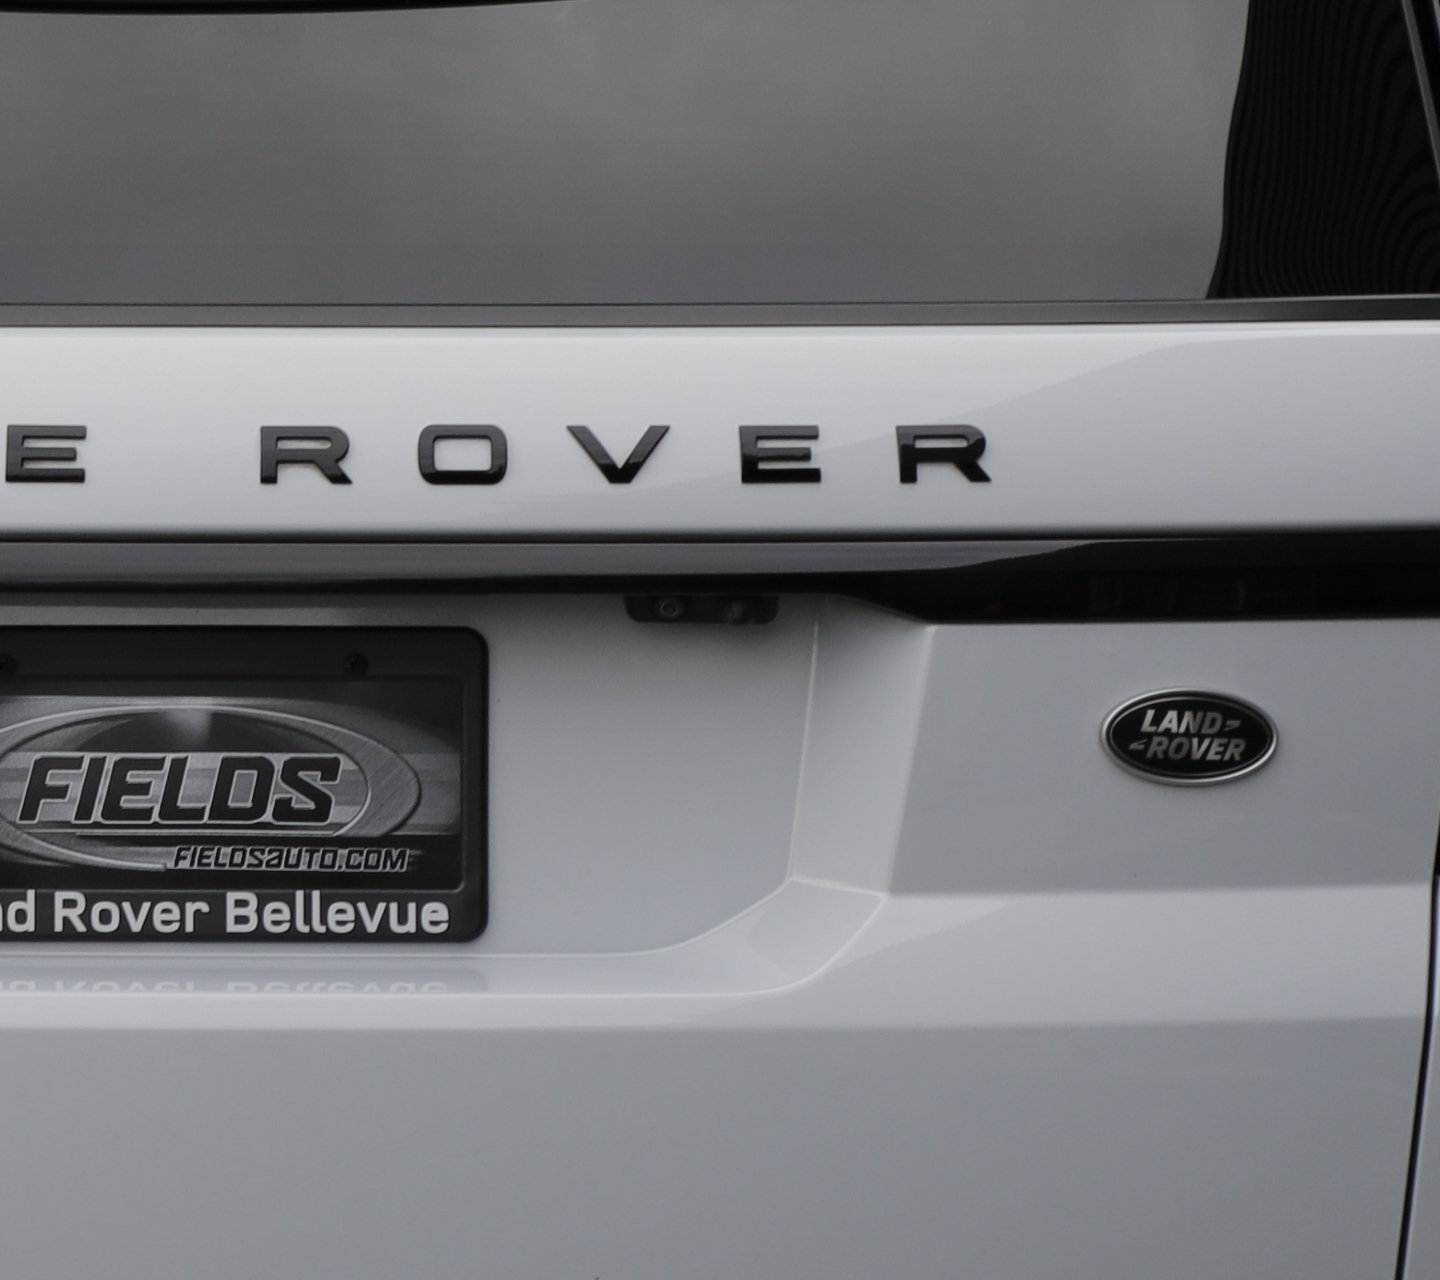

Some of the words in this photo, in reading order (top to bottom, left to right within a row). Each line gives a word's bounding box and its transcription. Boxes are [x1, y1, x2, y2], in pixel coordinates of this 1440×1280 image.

[258, 423, 993, 487] ROVER
[1140, 708, 1224, 735] LAND
[1145, 735, 1247, 762] ROVER
[17, 753, 348, 824] FIELDS
[53, 890, 210, 934] Rover
[225, 889, 450, 935] Bellevue
